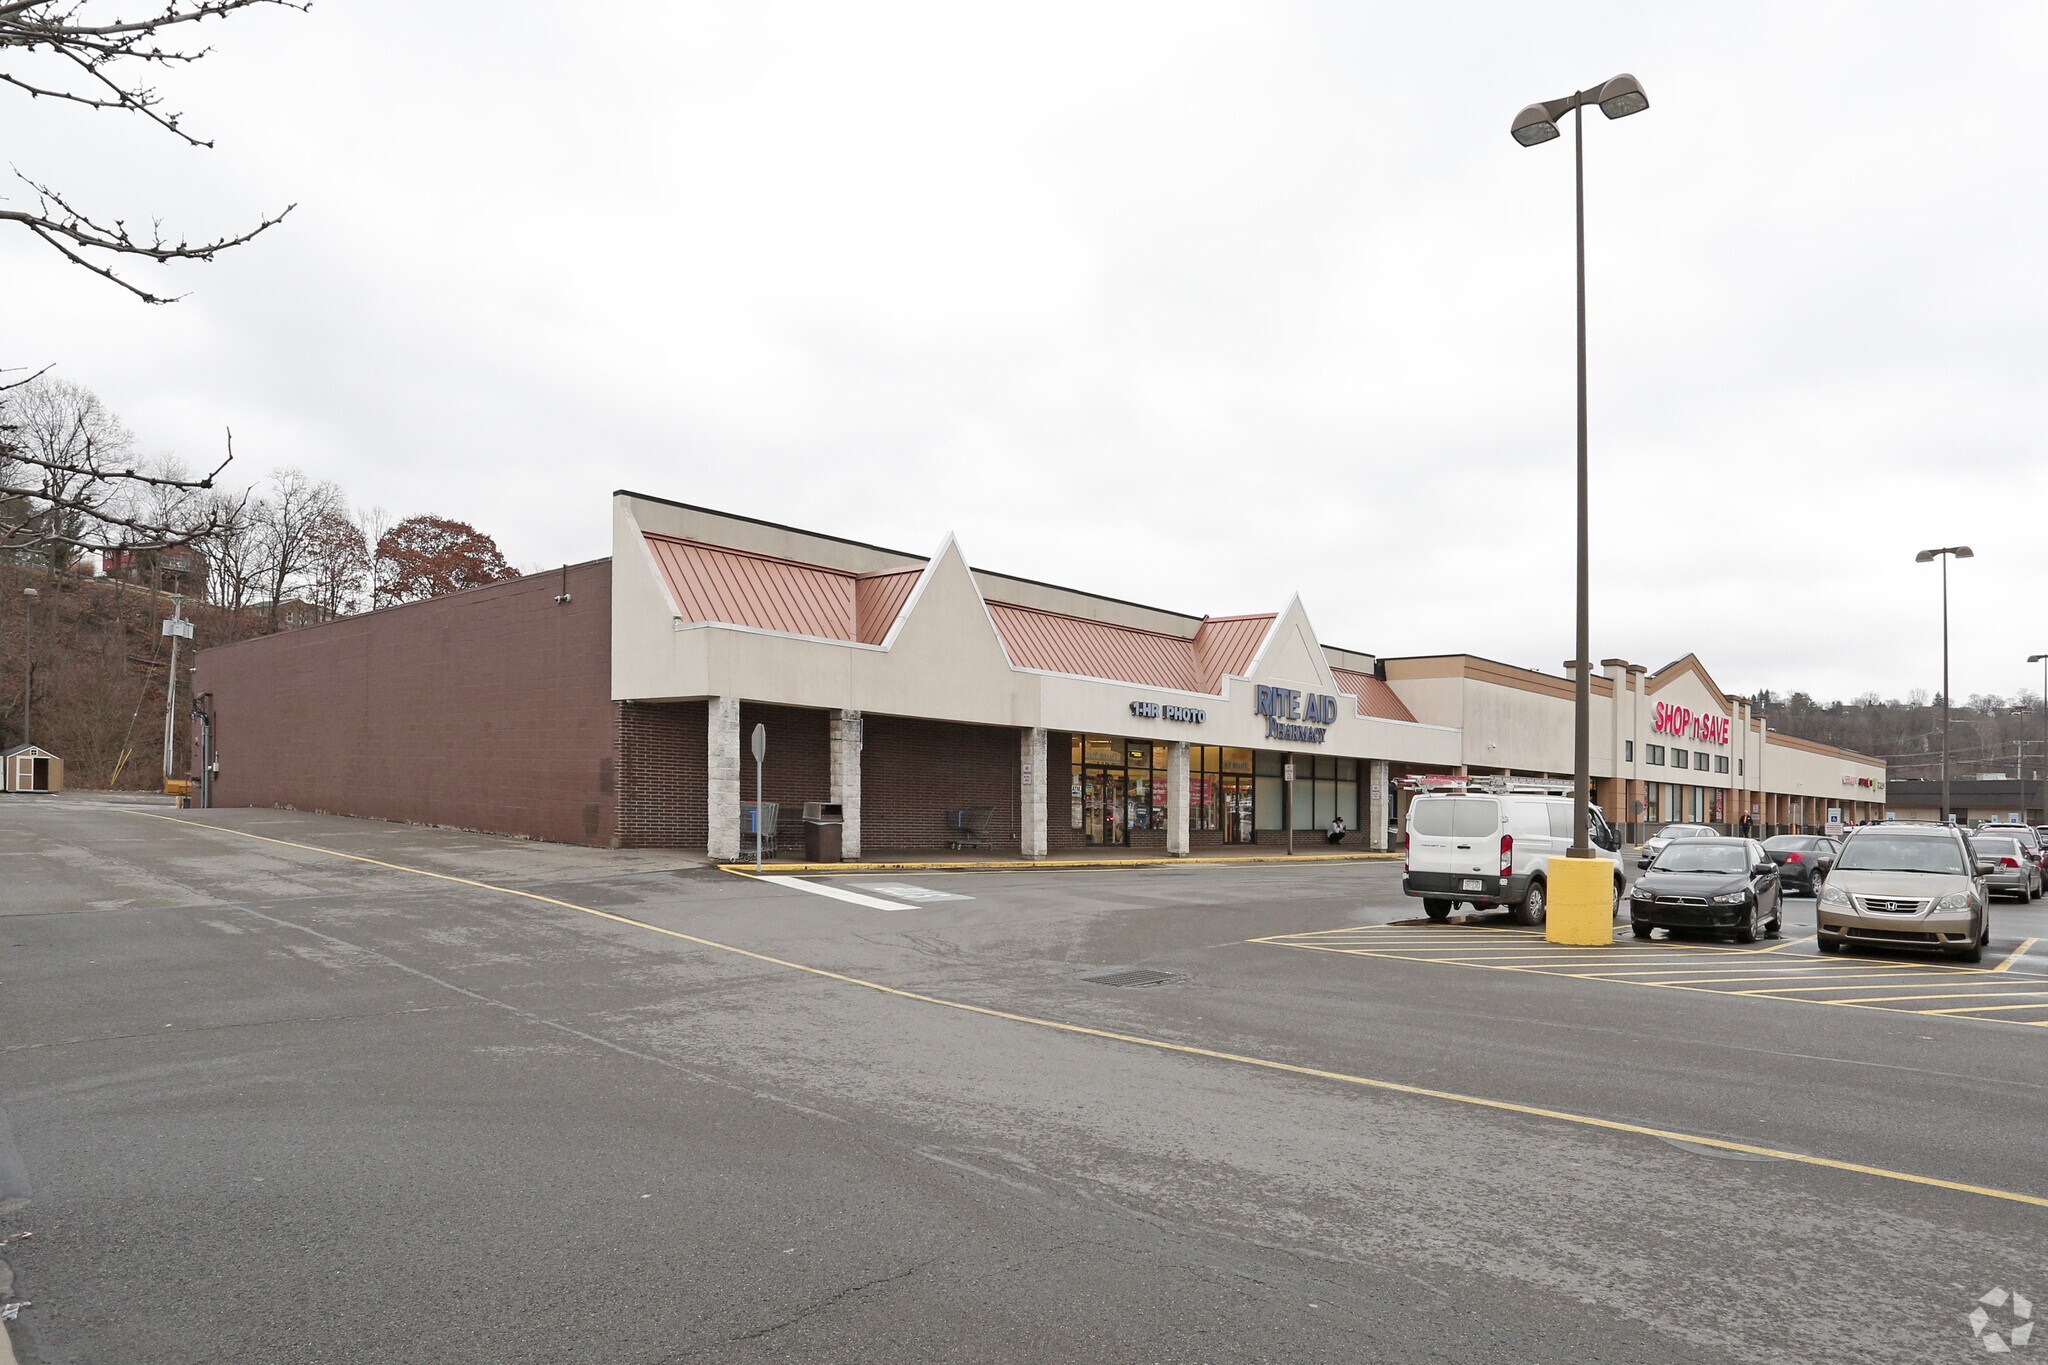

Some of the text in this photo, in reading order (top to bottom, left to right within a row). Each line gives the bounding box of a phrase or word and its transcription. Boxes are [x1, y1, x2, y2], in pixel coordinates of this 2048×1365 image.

[1130, 701, 1206, 724] 1-HR PHOTO
[1255, 684, 1338, 724] RITE AID
[1266, 716, 1327, 744] PHARMACY
[1652, 701, 1690, 736] SHOP
[1700, 713, 1729, 745] SAVE
